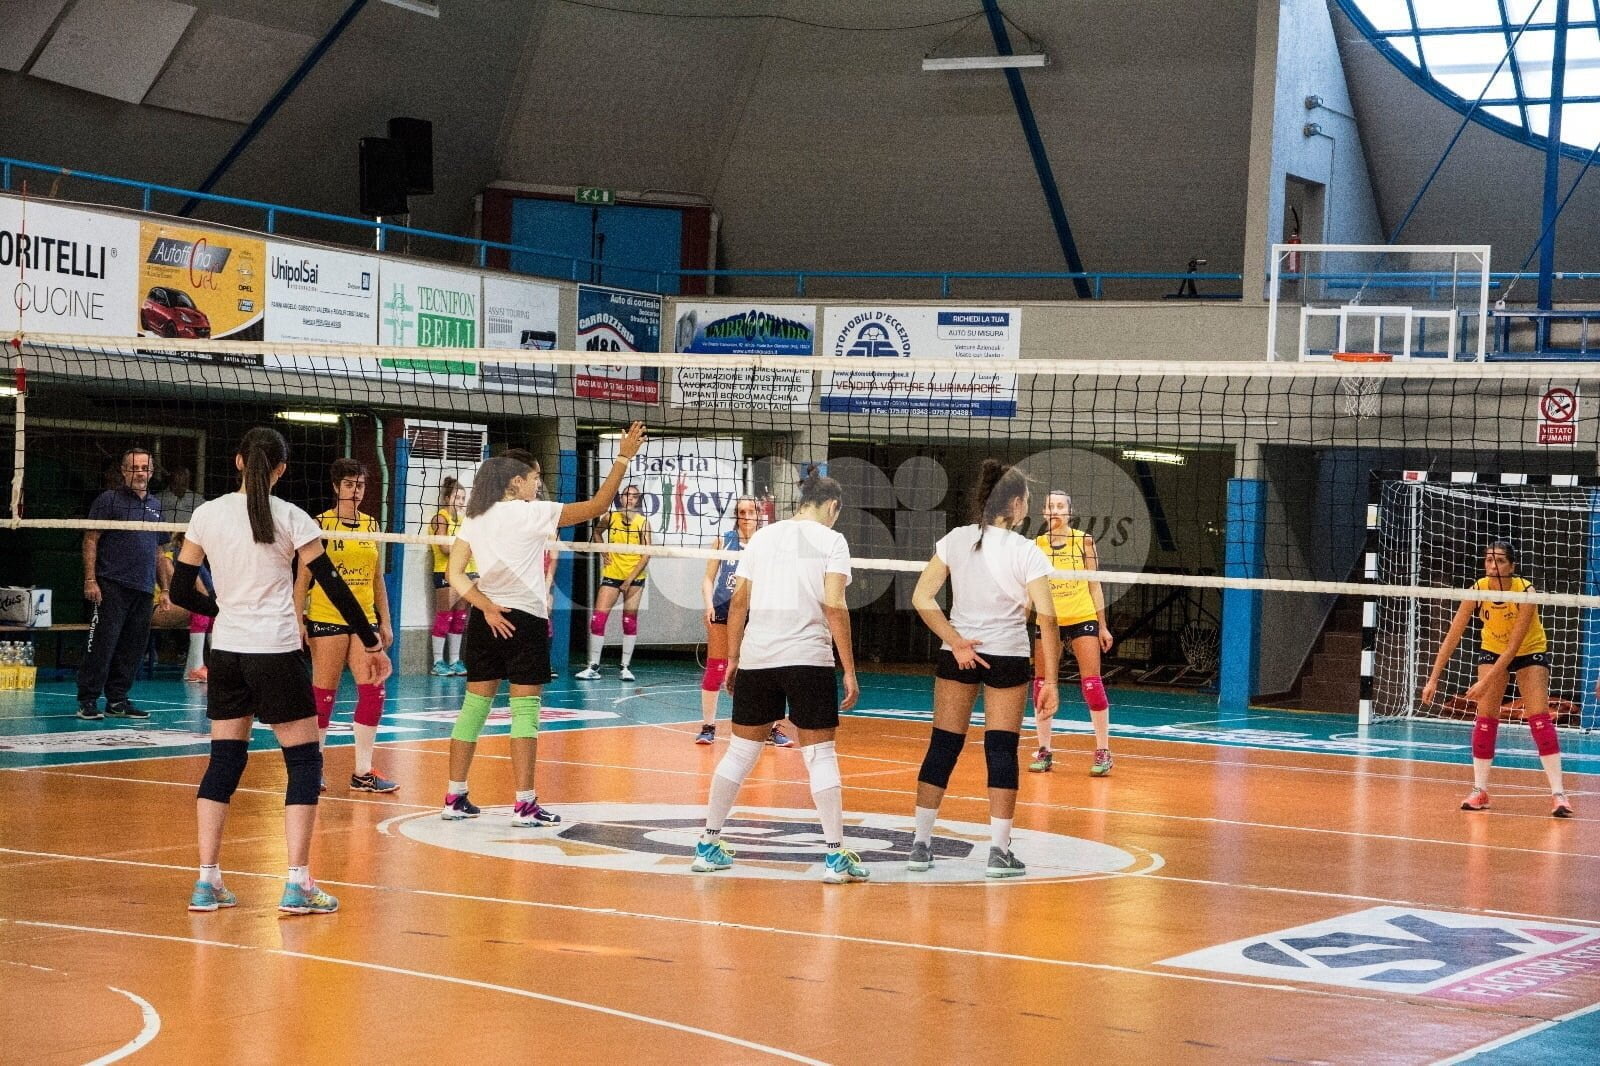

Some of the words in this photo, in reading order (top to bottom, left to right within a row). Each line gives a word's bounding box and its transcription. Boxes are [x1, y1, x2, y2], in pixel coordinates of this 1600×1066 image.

[0, 230, 105, 279] ORITELLI
[272, 256, 319, 288] UnipolSai
[14, 282, 104, 320] CUCINE
[418, 286, 475, 317] TECNIFON
[610, 295, 626, 304] Auto
[634, 299, 660, 309] cortesia
[579, 313, 635, 344] CARROZZERIA
[835, 312, 873, 356] UTOMOBILI
[875, 311, 911, 357] D'ECCEZION
[683, 372, 743, 381] AUTOMAZIONE
[745, 374, 801, 383] INDUSTRIALE
[835, 380, 879, 391] VENDITA
[683, 391, 718, 399] IMPIANTI
[720, 392, 751, 400] BORDO
[753, 393, 799, 402] MACCHINA
[1541, 434, 1572, 442] FUMARE
[635, 453, 709, 472] Bastia
[333, 540, 345, 552] 14
[1450, 956, 1594, 998] FACTORY
